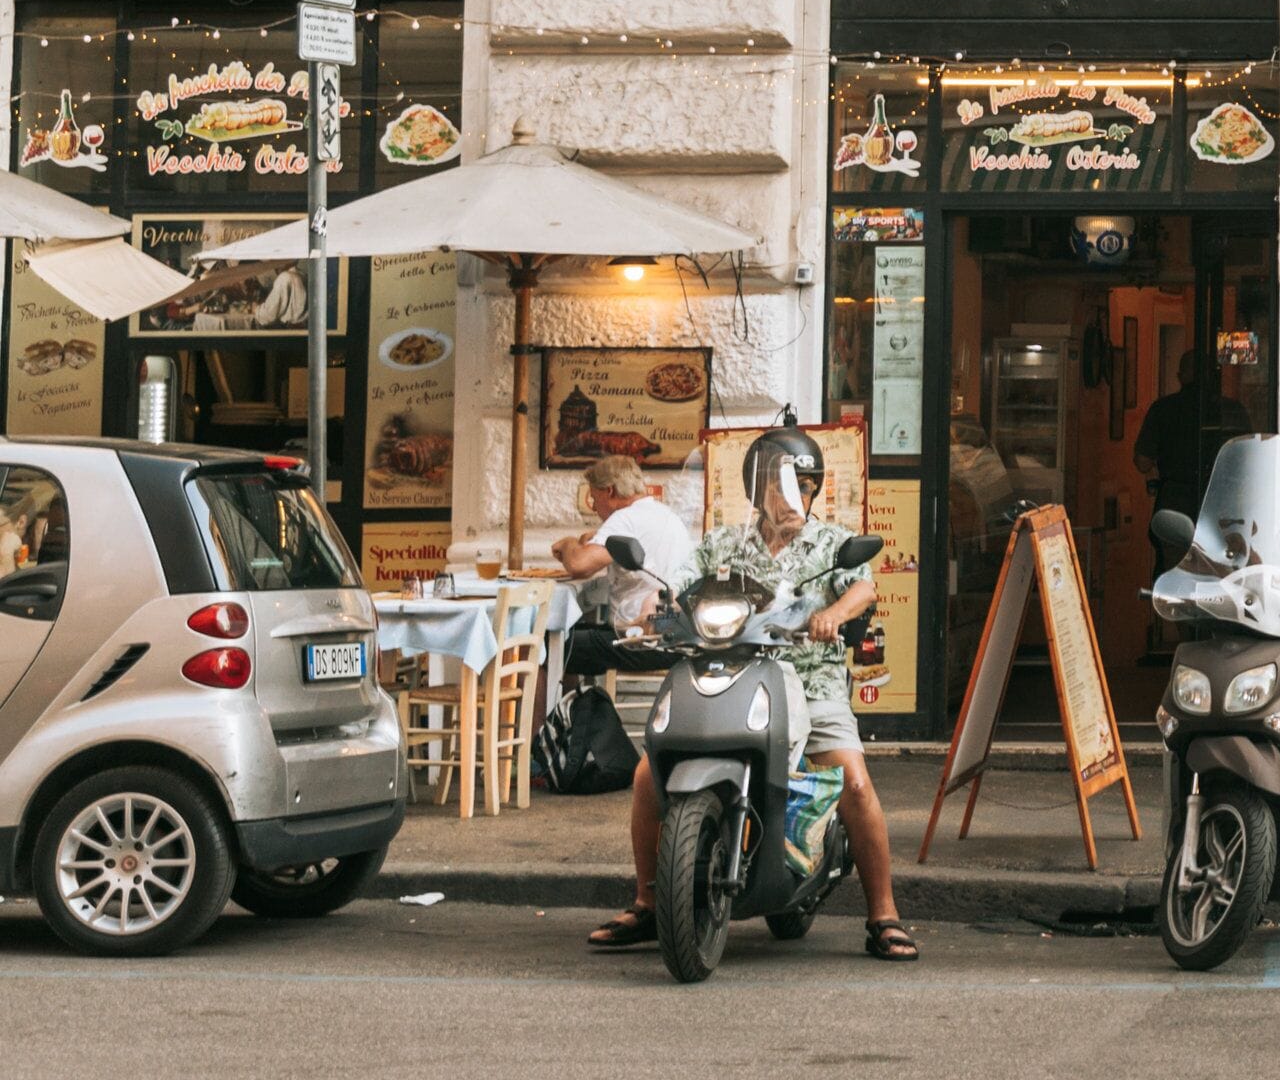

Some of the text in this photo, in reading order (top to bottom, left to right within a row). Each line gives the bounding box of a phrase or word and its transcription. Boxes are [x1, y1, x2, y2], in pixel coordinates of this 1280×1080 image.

[137, 90, 168, 120] La
[168, 61, 253, 110] fraschetta
[254, 62, 286, 93] der
[957, 99, 984, 126] La
[1103, 86, 1156, 125] Panino
[147, 142, 343, 176] Vecchia Ostea
[969, 144, 1141, 171] Vecchia Osteria
[867, 216, 907, 226] SPORTS
[143, 224, 210, 248] Vecchia
[570, 368, 609, 381] Pizza
[588, 382, 644, 396] Romana
[369, 492, 380, 504] No
[382, 491, 411, 504] Service
[413, 492, 443, 505] Charge
[868, 521, 892, 531] cina
[315, 646, 360, 676] DS 809NF
